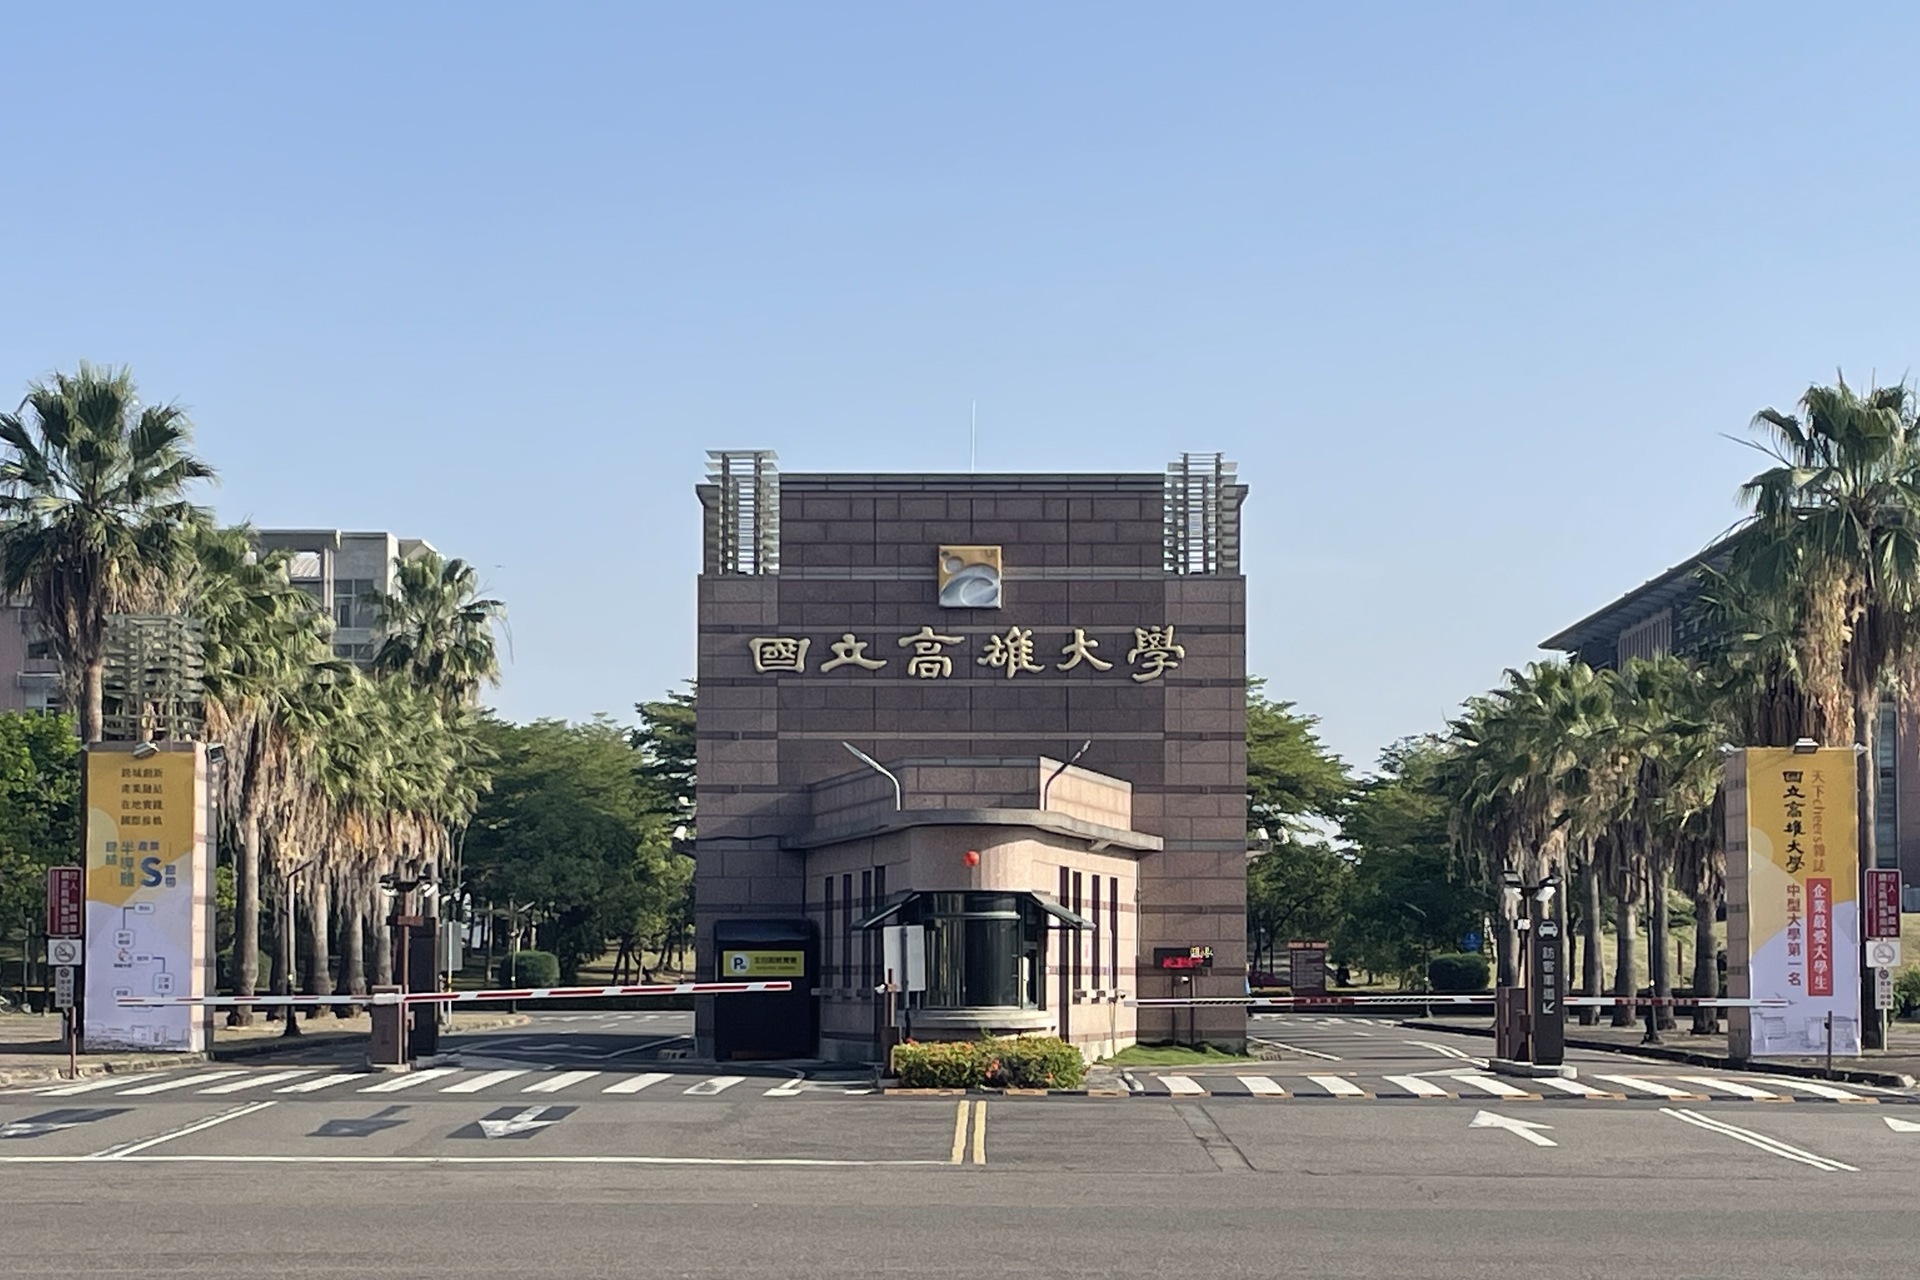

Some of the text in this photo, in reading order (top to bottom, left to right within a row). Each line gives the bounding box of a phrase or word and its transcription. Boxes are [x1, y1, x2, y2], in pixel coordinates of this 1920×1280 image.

[748, 626, 1186, 683] 國立高雄大學
[1782, 770, 1806, 873] 國立高雄大學
[1786, 883, 1802, 986] 中型大學第一名
[1813, 883, 1828, 990] 企業最愛大學生
